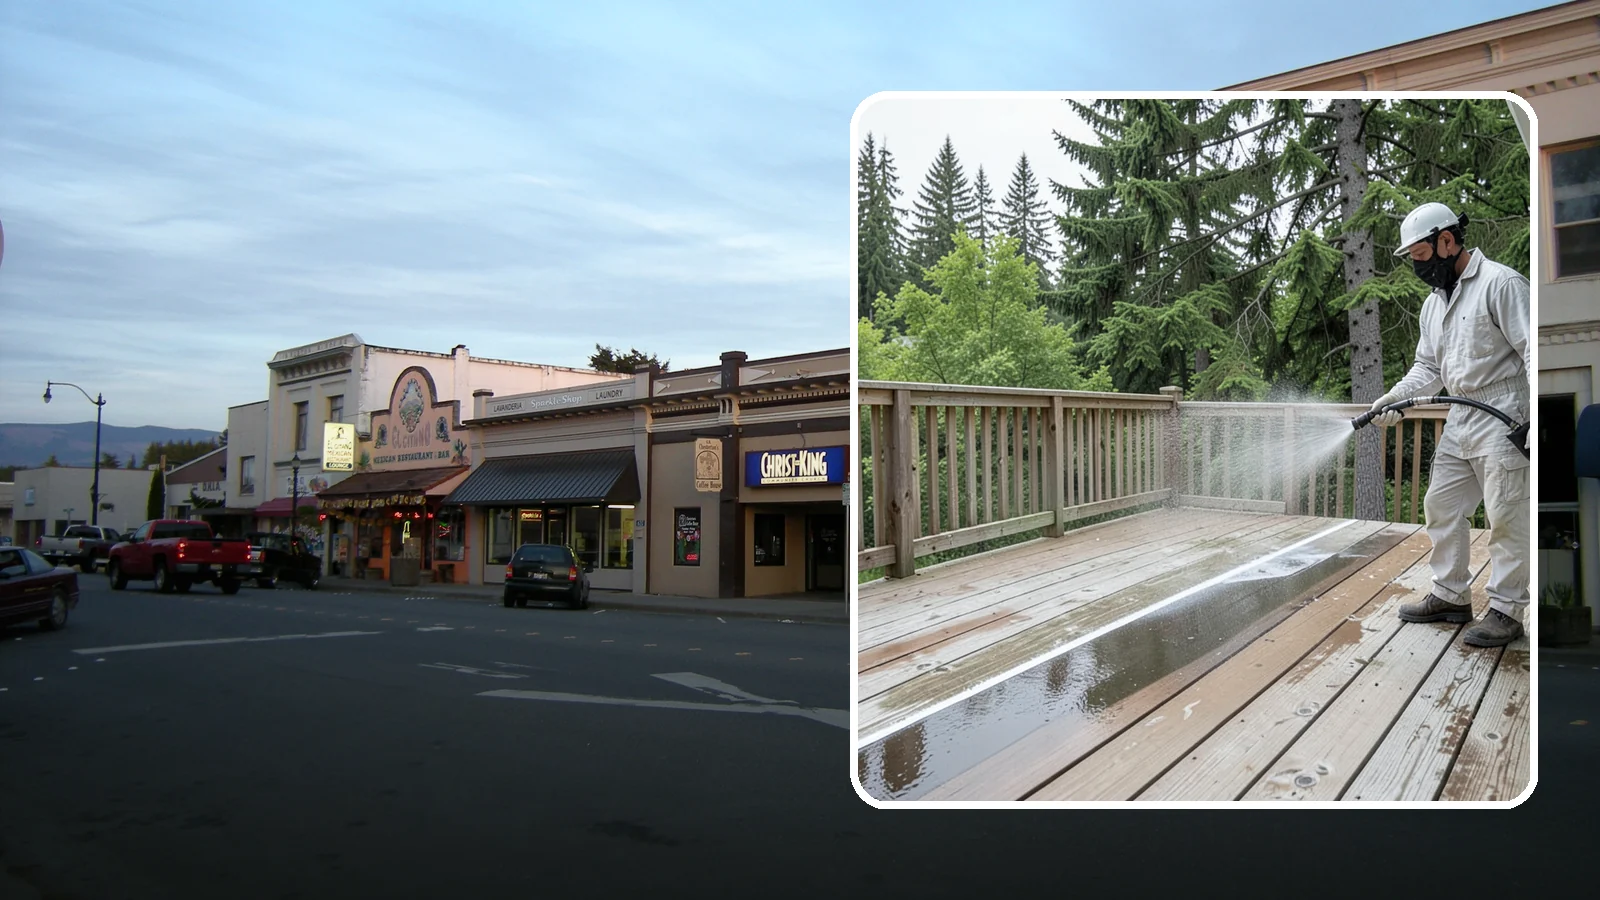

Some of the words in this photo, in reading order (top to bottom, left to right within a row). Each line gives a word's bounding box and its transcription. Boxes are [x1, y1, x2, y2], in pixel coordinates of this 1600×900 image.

[562, 393, 582, 406] Shop
[595, 389, 623, 400] LAUNDRY
[493, 402, 524, 413] LAVANDERIA
[374, 455, 396, 464] MEXICAN
[397, 451, 433, 462] RESTAURANT
[438, 450, 450, 459] BAR
